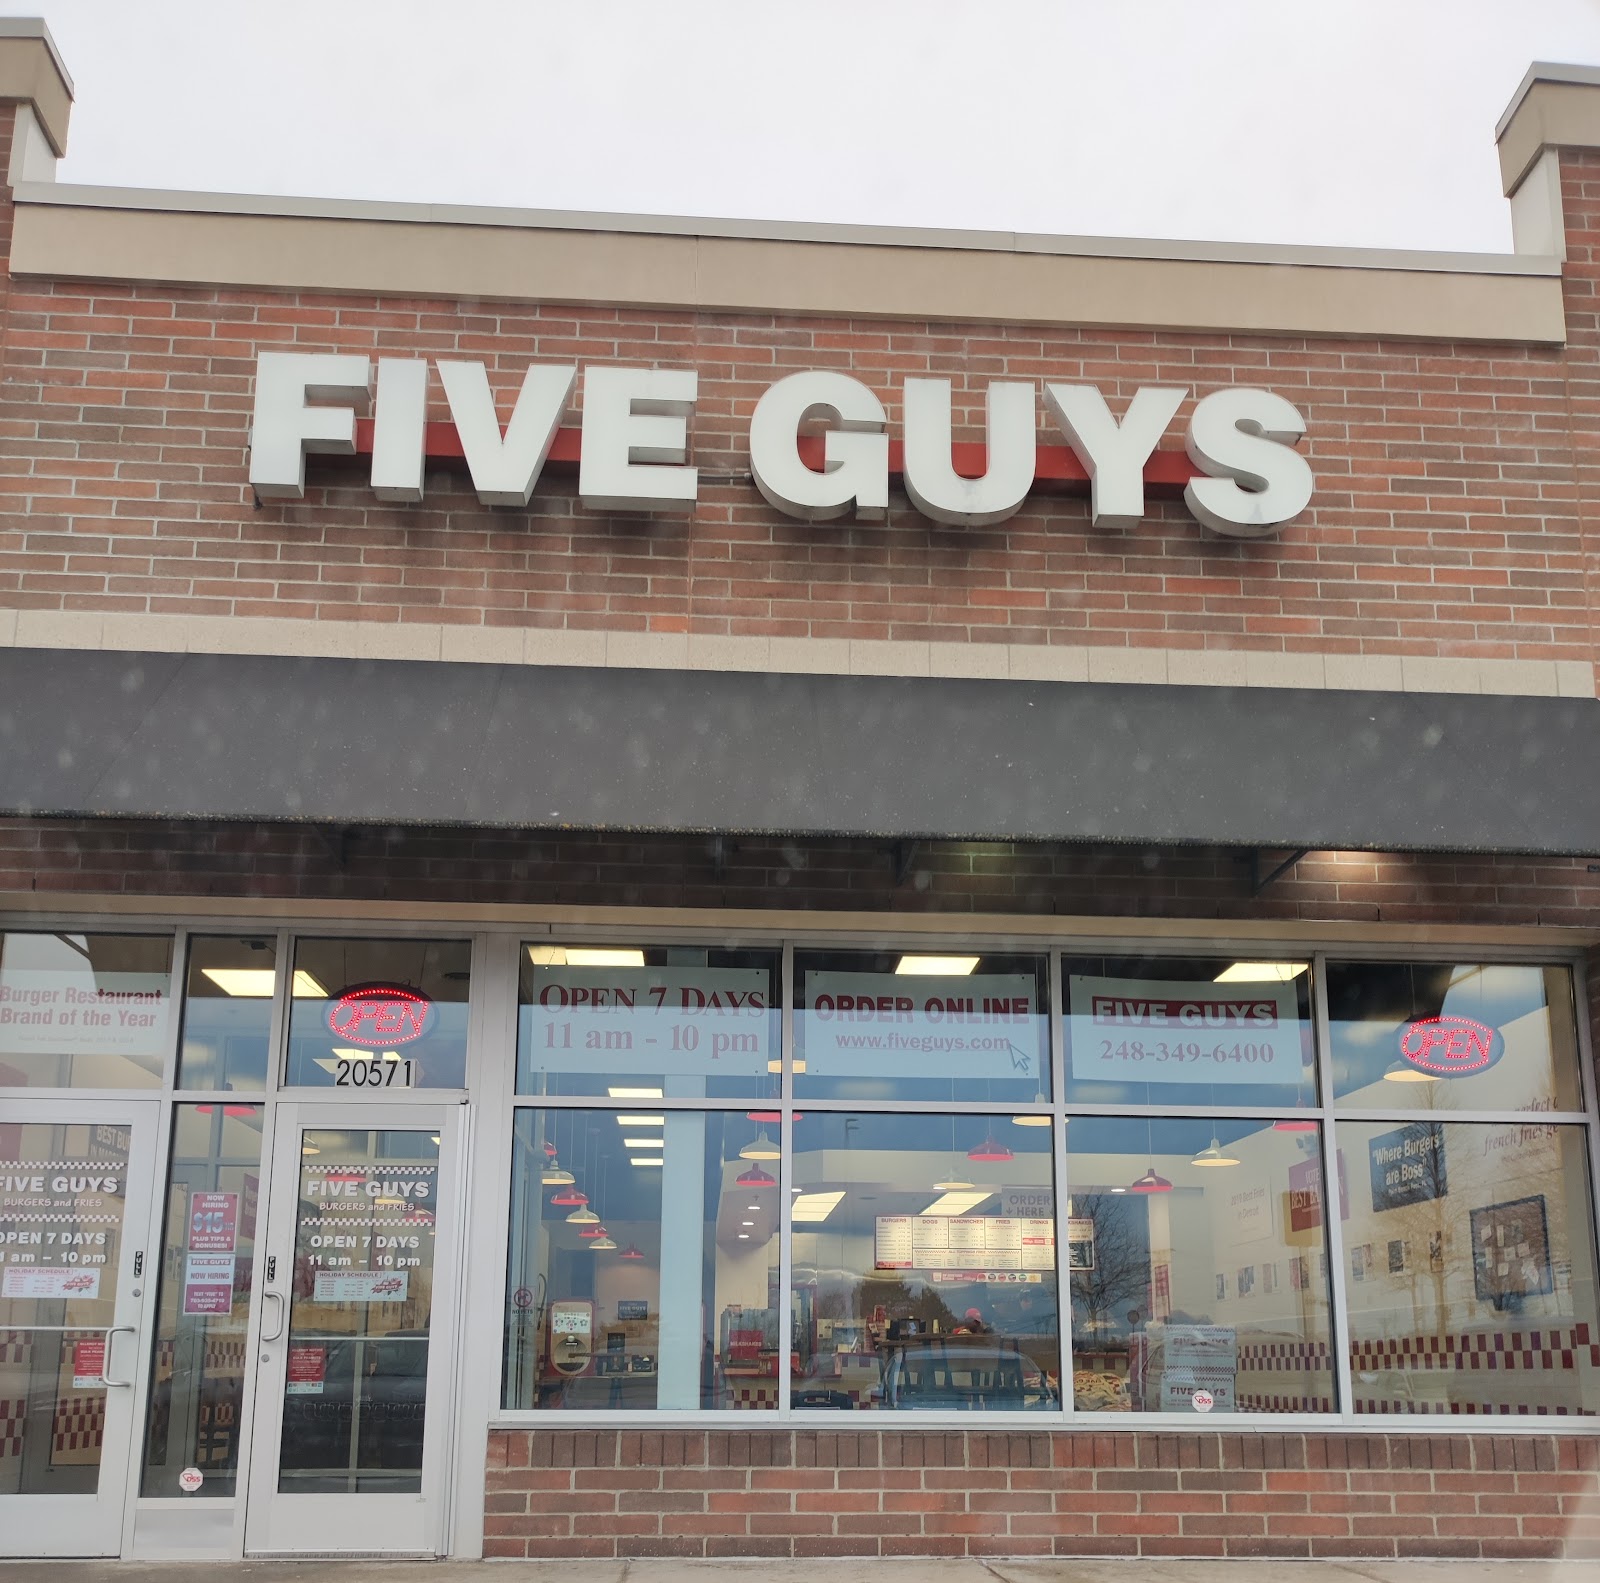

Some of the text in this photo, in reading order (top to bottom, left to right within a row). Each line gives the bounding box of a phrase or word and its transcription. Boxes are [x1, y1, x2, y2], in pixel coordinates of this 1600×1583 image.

[249, 351, 1314, 537] FIVE GUYS
[0, 986, 162, 1006] Burger Restaurant
[649, 987, 667, 1015] 7
[0, 1007, 156, 1027] Brand of the Year
[330, 1000, 429, 1034] OPEN
[815, 994, 1029, 1024] ORDER ONLINE
[1095, 1000, 1274, 1027] FIVE GUYS
[544, 1022, 573, 1048] 11
[585, 1030, 633, 1049] am
[671, 1024, 699, 1051] 10
[712, 1033, 759, 1059] pm
[836, 1033, 1010, 1052] www.fiveguys.com
[1401, 1027, 1493, 1061] OPEN
[1101, 1040, 1274, 1063] 248-349-6400
[337, 1060, 411, 1087] 20571
[1404, 1135, 1440, 1157] Burgers
[52, 1176, 118, 1193] GUYS
[1386, 1170, 1400, 1186] are
[307, 1181, 429, 1198] FIVE GUYS
[1291, 1187, 1306, 1209] BEST
[4, 1198, 102, 1207] BURGERS and FRIES
[319, 1202, 415, 1211] BURGERS and FRIES
[1010, 1195, 1050, 1205] ORDER
[1017, 1207, 1044, 1216] HERE
[193, 1212, 224, 1233] $15
[46, 1232, 57, 1244] 7
[61, 1232, 106, 1245] DAYS
[310, 1235, 420, 1248] OPEN 7 DAYS
[11, 1253, 36, 1263] am
[60, 1251, 79, 1263] 10
[82, 1254, 107, 1265] pm
[308, 1255, 322, 1266] 11
[328, 1258, 352, 1266] am
[376, 1255, 393, 1267] 10
[397, 1258, 420, 1268] pm
[1170, 1387, 1194, 1395] FIVE
